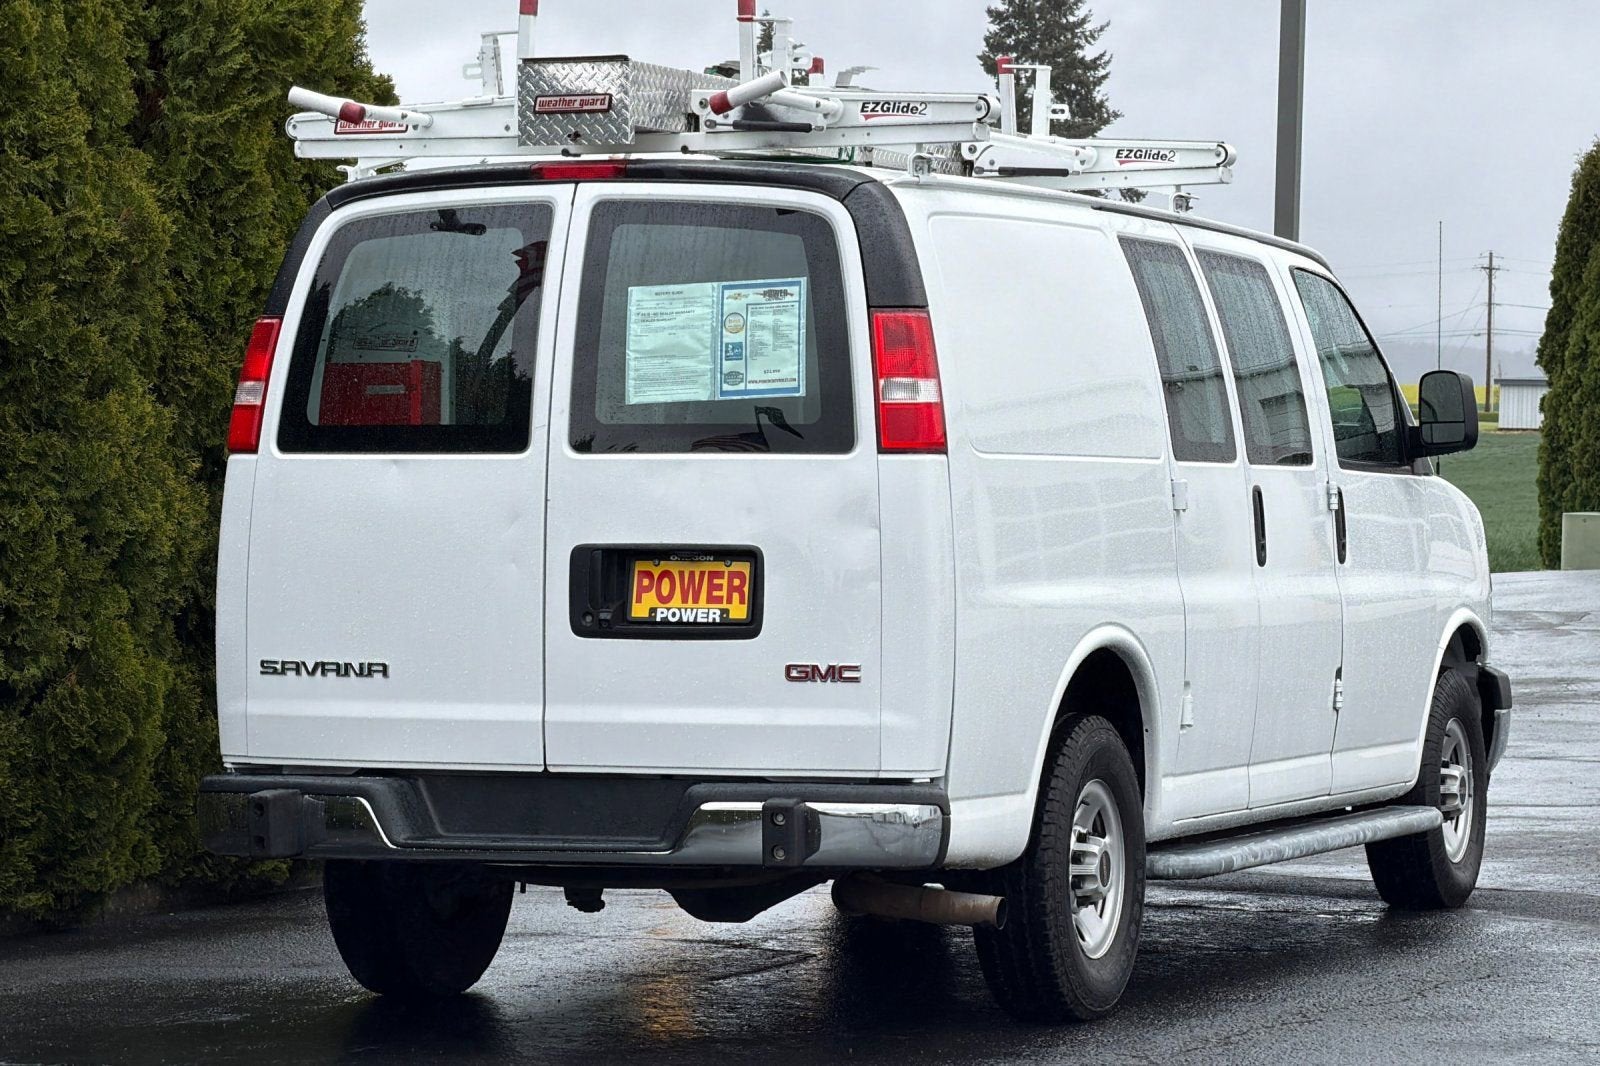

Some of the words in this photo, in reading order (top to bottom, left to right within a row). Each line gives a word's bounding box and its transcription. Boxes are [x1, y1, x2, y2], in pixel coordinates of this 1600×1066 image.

[538, 97, 577, 108] weather
[579, 96, 607, 108] guard
[860, 101, 928, 116] EZGlide2
[1115, 149, 1176, 163] EZGlide2
[635, 569, 747, 605] POWER
[656, 607, 721, 623] POWER
[260, 659, 390, 679] SAVANA
[784, 664, 861, 683] GMC
